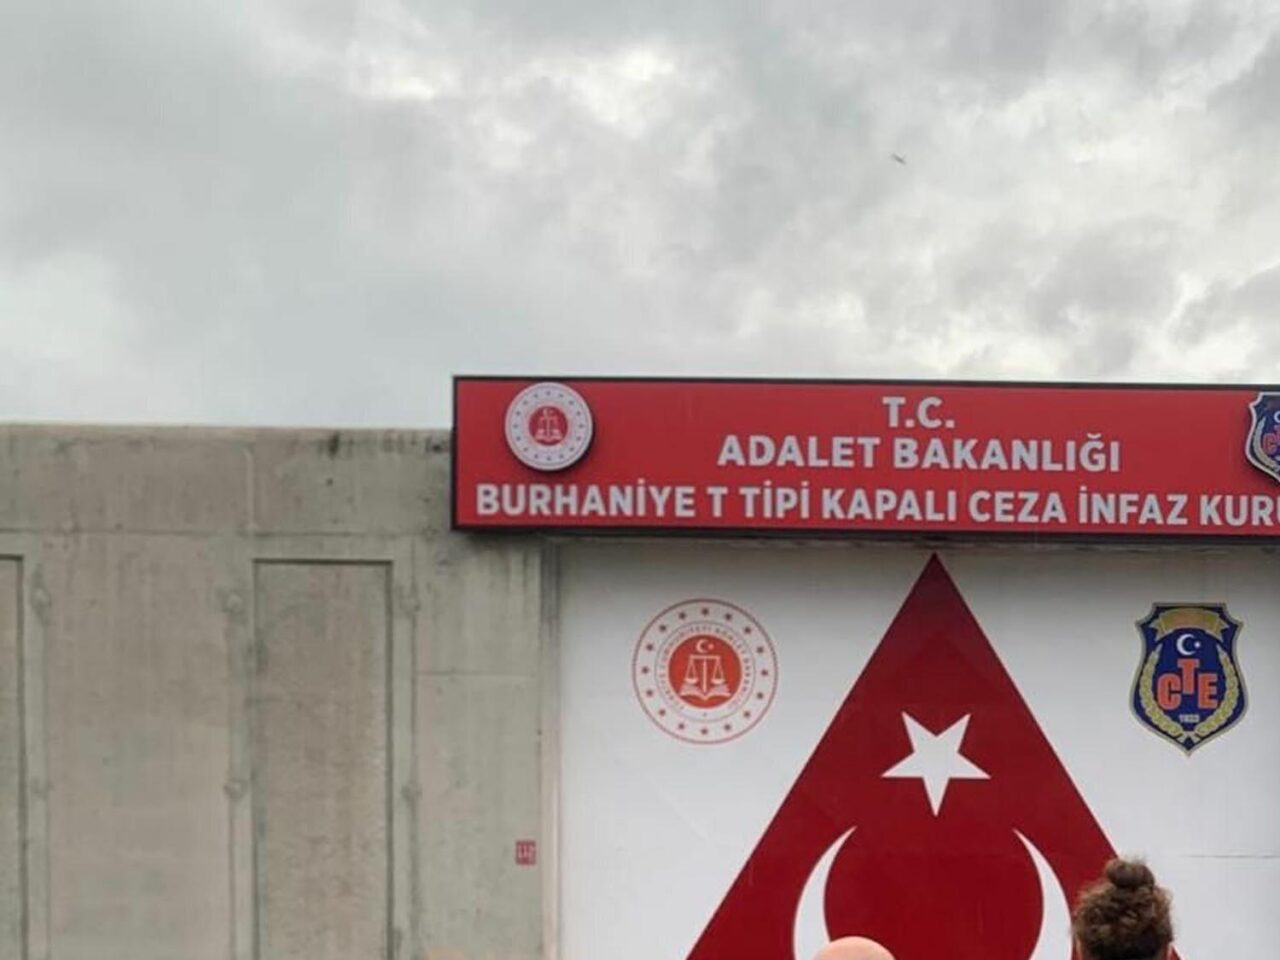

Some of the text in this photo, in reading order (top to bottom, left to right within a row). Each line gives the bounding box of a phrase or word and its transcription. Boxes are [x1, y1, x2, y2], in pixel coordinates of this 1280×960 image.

[882, 396, 955, 428] T.C.
[717, 433, 1120, 472] ADALET BAKANLIĞI
[475, 478, 696, 516] BURHANİYE
[706, 487, 729, 516] T
[739, 480, 810, 518] TİPİ
[821, 488, 957, 522] KAPALI
[968, 490, 1067, 523] CEZA
[1078, 485, 1188, 525] İNFAZ
[1157, 658, 1218, 710] CTE
